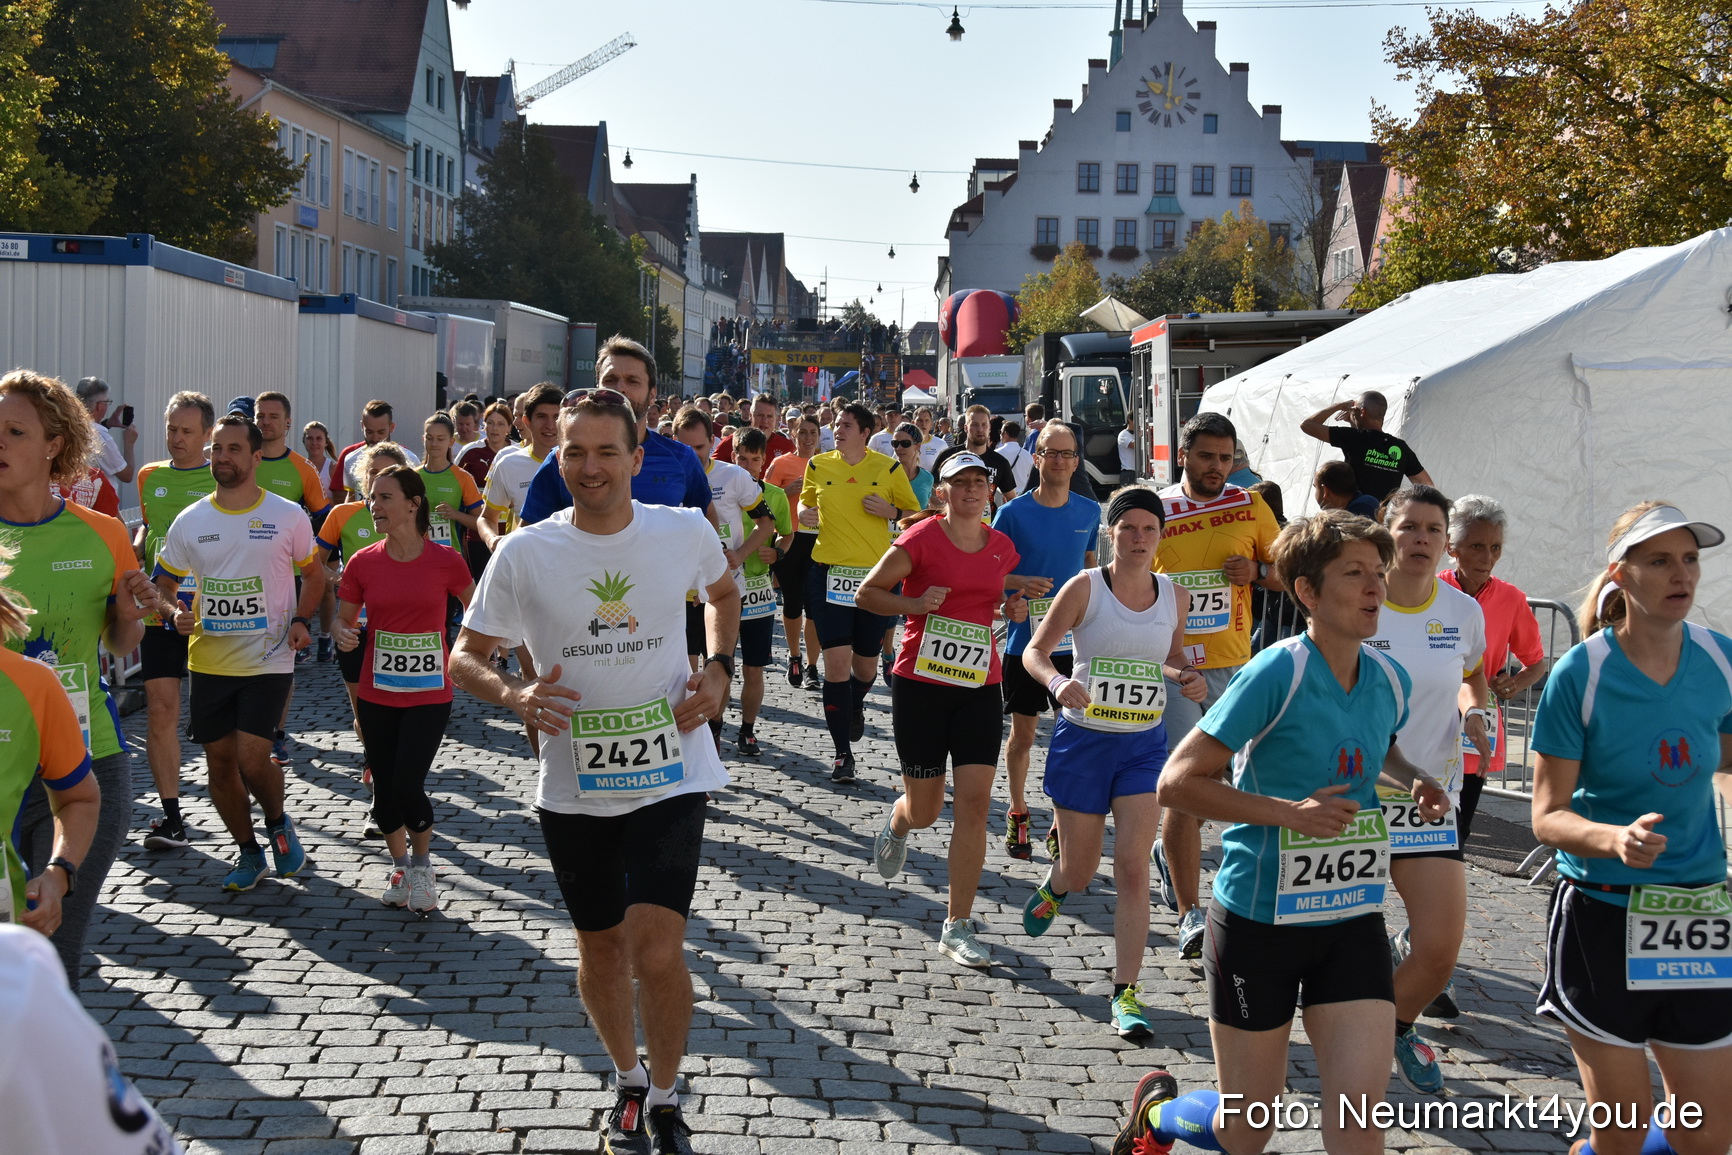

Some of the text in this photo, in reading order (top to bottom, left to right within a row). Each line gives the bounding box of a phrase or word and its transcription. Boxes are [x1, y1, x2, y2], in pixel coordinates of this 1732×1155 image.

[787, 353, 824, 363] START
[1365, 456, 1398, 468] neumarkt
[1163, 510, 1256, 539] MAX BÖGL
[52, 560, 93, 571] BOCK
[206, 578, 260, 595] BOCK
[832, 578, 862, 592] 205
[207, 597, 258, 616] 2045
[747, 606, 770, 614] ANDRE
[211, 621, 256, 630] THOMAS
[931, 618, 987, 643] BOCK
[1186, 618, 1216, 627] VIDIU
[1427, 623, 1443, 634] 20
[381, 634, 436, 650] BOCK
[562, 637, 664, 658] GESUND UND FIT
[594, 656, 635, 667] mit Julia
[931, 639, 984, 666] 1077
[381, 653, 436, 673] 2828
[927, 662, 976, 680] MARTINA
[1096, 660, 1159, 681] BOCK
[1098, 681, 1158, 706] 1157
[578, 703, 668, 734] BOCK
[1092, 707, 1155, 721] CHRISTINA
[585, 733, 668, 769] 2421
[595, 771, 669, 787] MICHAEL
[1389, 833, 1447, 845] EPHANIE
[1292, 849, 1377, 886] 2462
[1295, 889, 1366, 910] MELANIE
[1639, 888, 1730, 913] BOCK
[1640, 919, 1731, 950] 2463
[1656, 962, 1716, 976] PETRA
[1237, 987, 1248, 1018] odlo
